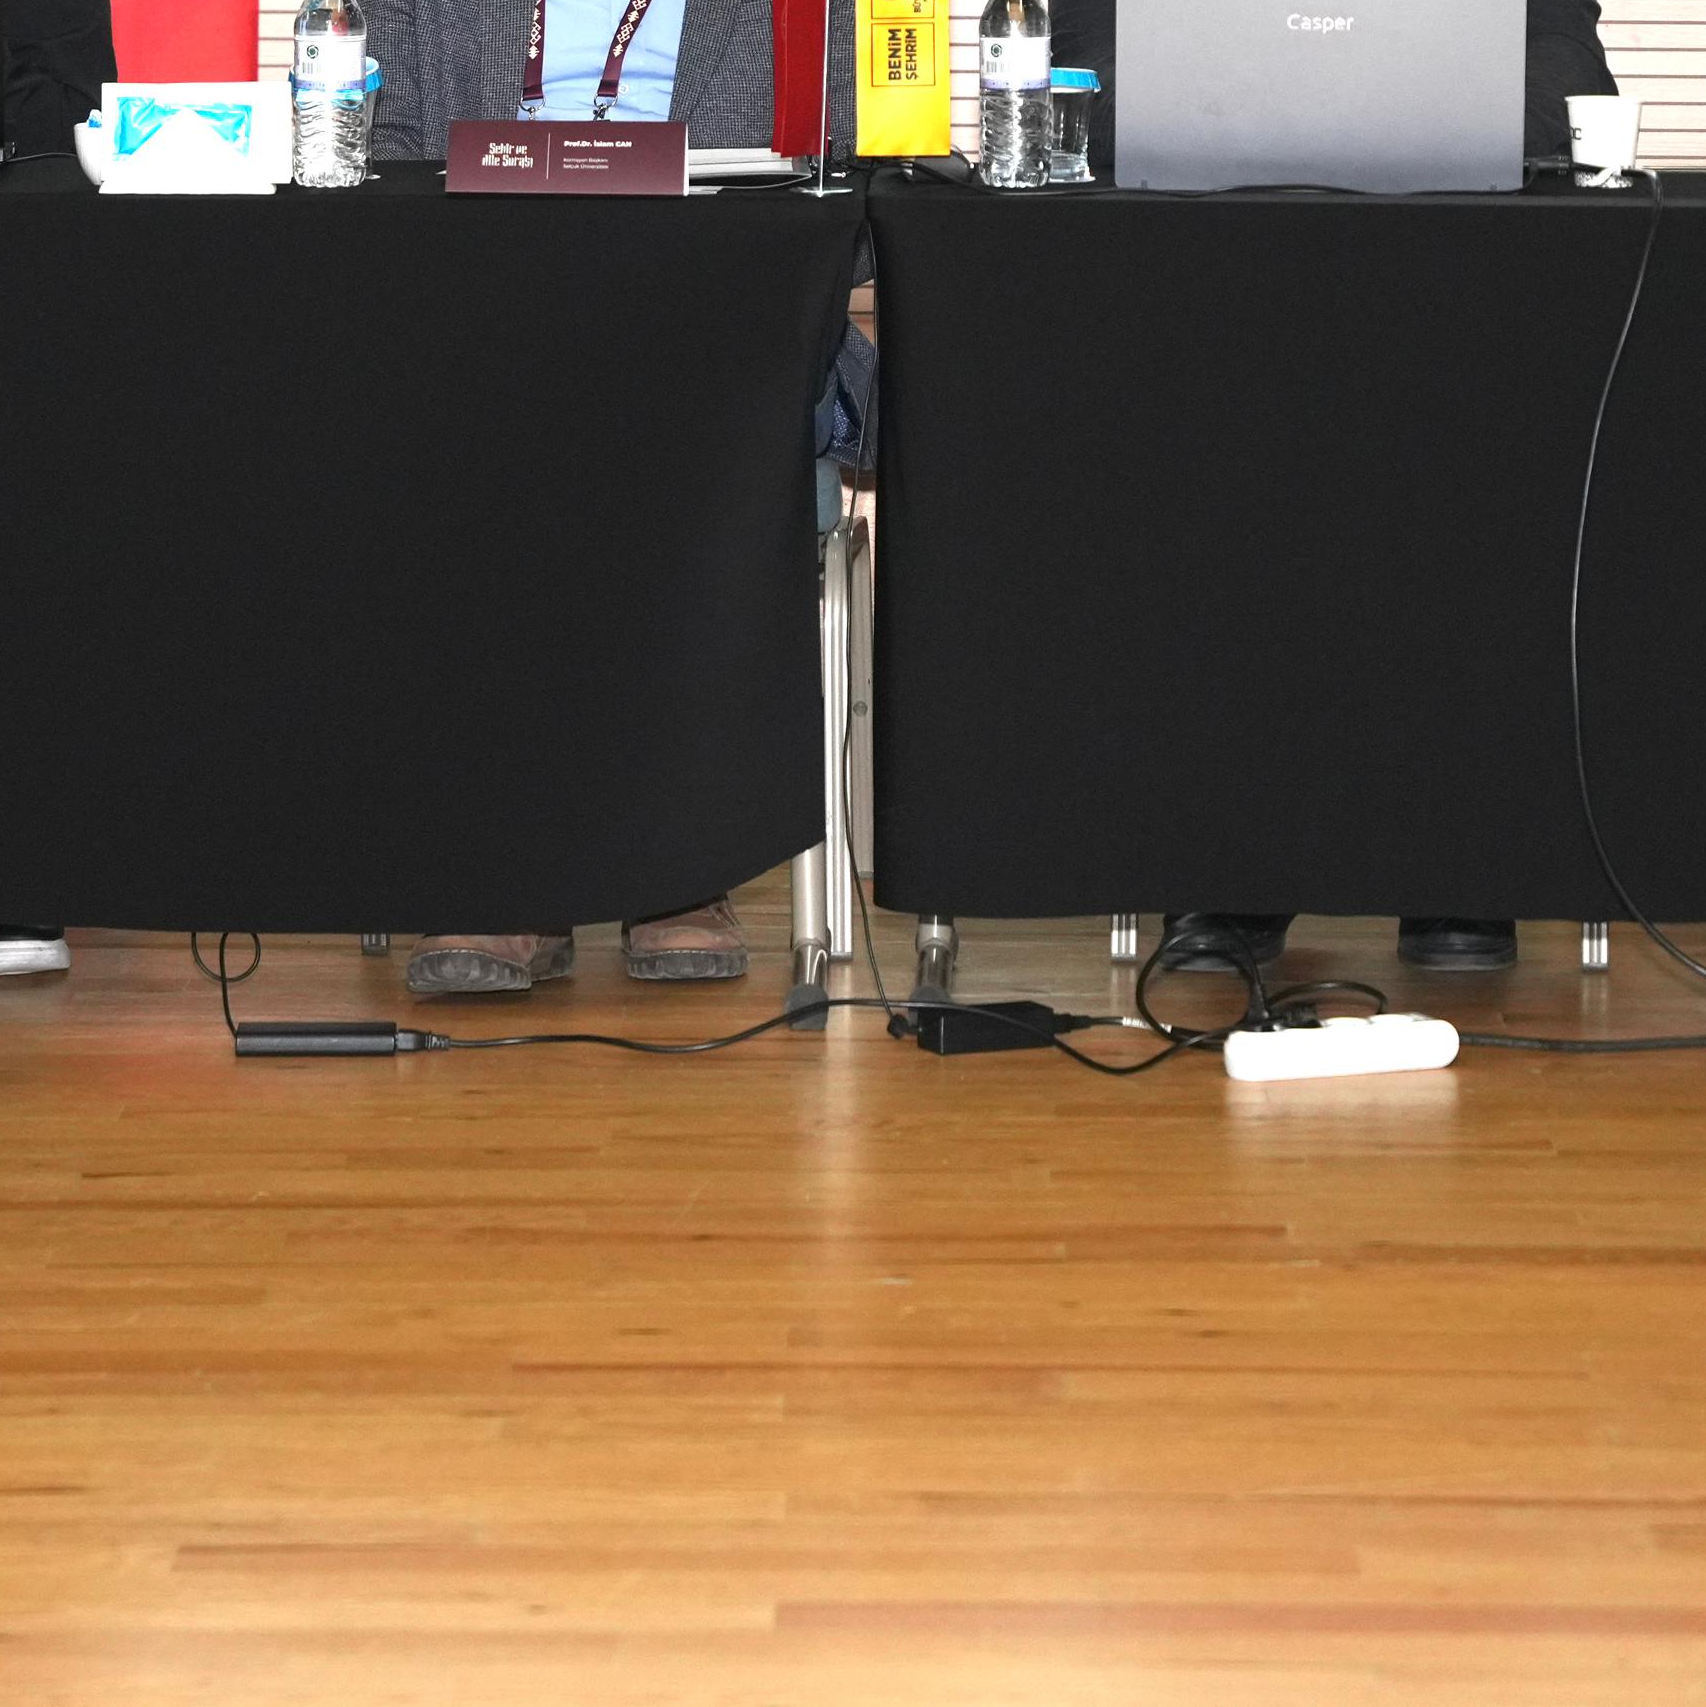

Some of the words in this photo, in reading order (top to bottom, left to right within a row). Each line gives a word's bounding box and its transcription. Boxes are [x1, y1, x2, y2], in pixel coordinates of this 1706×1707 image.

[1286, 12, 1356, 35] Casper
[888, 28, 903, 81] BENİM
[906, 28, 920, 81] ŞEHRİM
[615, 140, 633, 148] CAN
